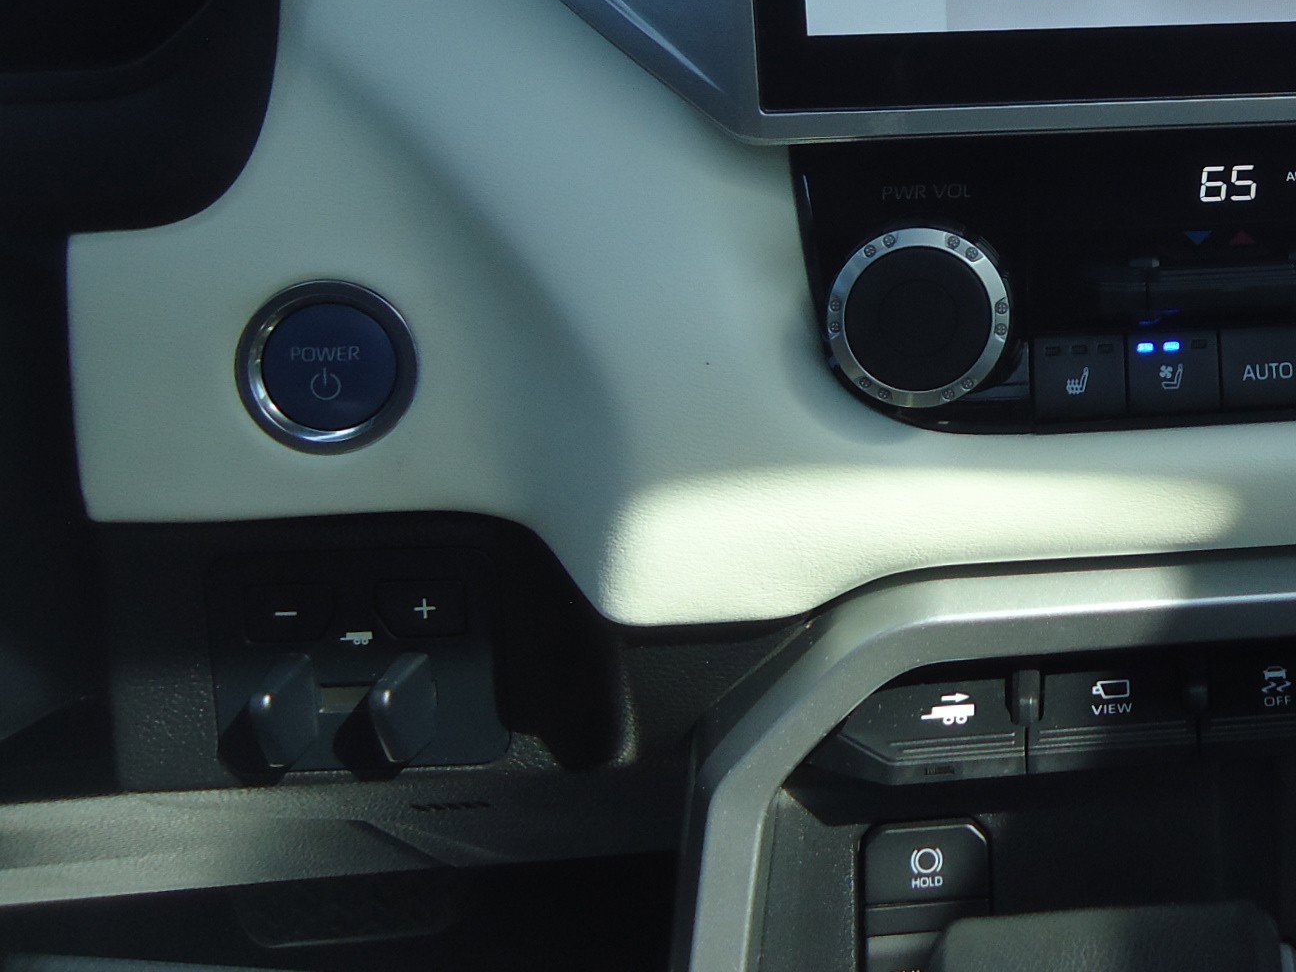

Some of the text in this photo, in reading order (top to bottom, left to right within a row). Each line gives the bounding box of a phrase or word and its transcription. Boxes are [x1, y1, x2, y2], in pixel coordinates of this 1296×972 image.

[881, 183, 971, 201] PWR VOL
[1200, 165, 1257, 202] 65
[290, 345, 360, 362] POWER
[1242, 361, 1293, 381] AUTO
[1091, 703, 1132, 715] VIEW
[1264, 695, 1292, 708] OFF
[911, 875, 944, 888] HOLD
